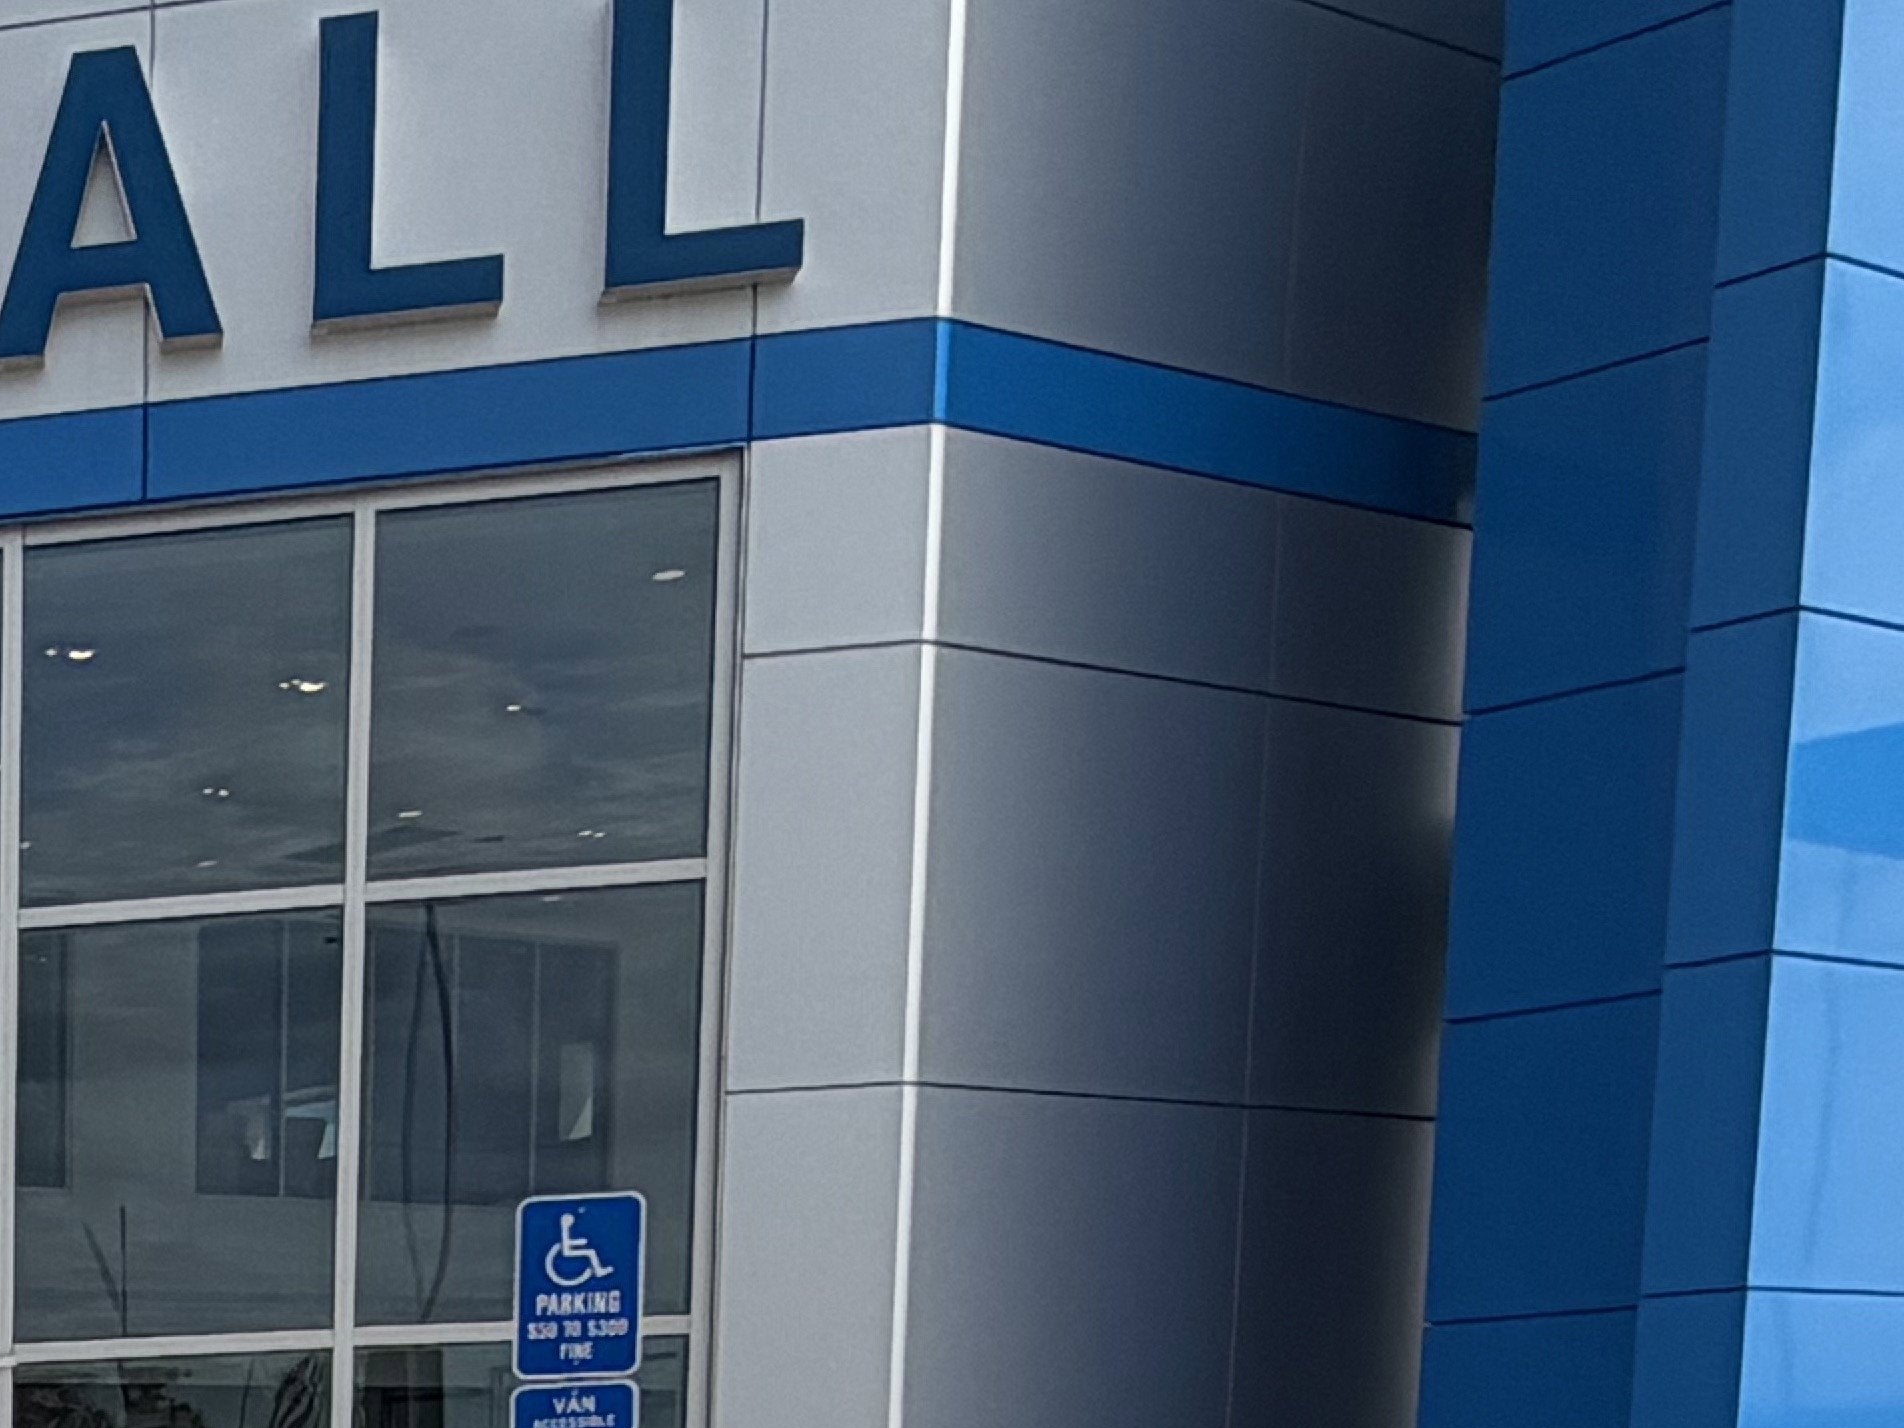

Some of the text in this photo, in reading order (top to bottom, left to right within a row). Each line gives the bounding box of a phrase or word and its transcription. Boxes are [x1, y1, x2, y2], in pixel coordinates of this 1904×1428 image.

[535, 1290, 621, 1315] PARKING
[562, 1320, 582, 1337] TO
[560, 1341, 593, 1360] FINE
[553, 1395, 596, 1414] VAN
